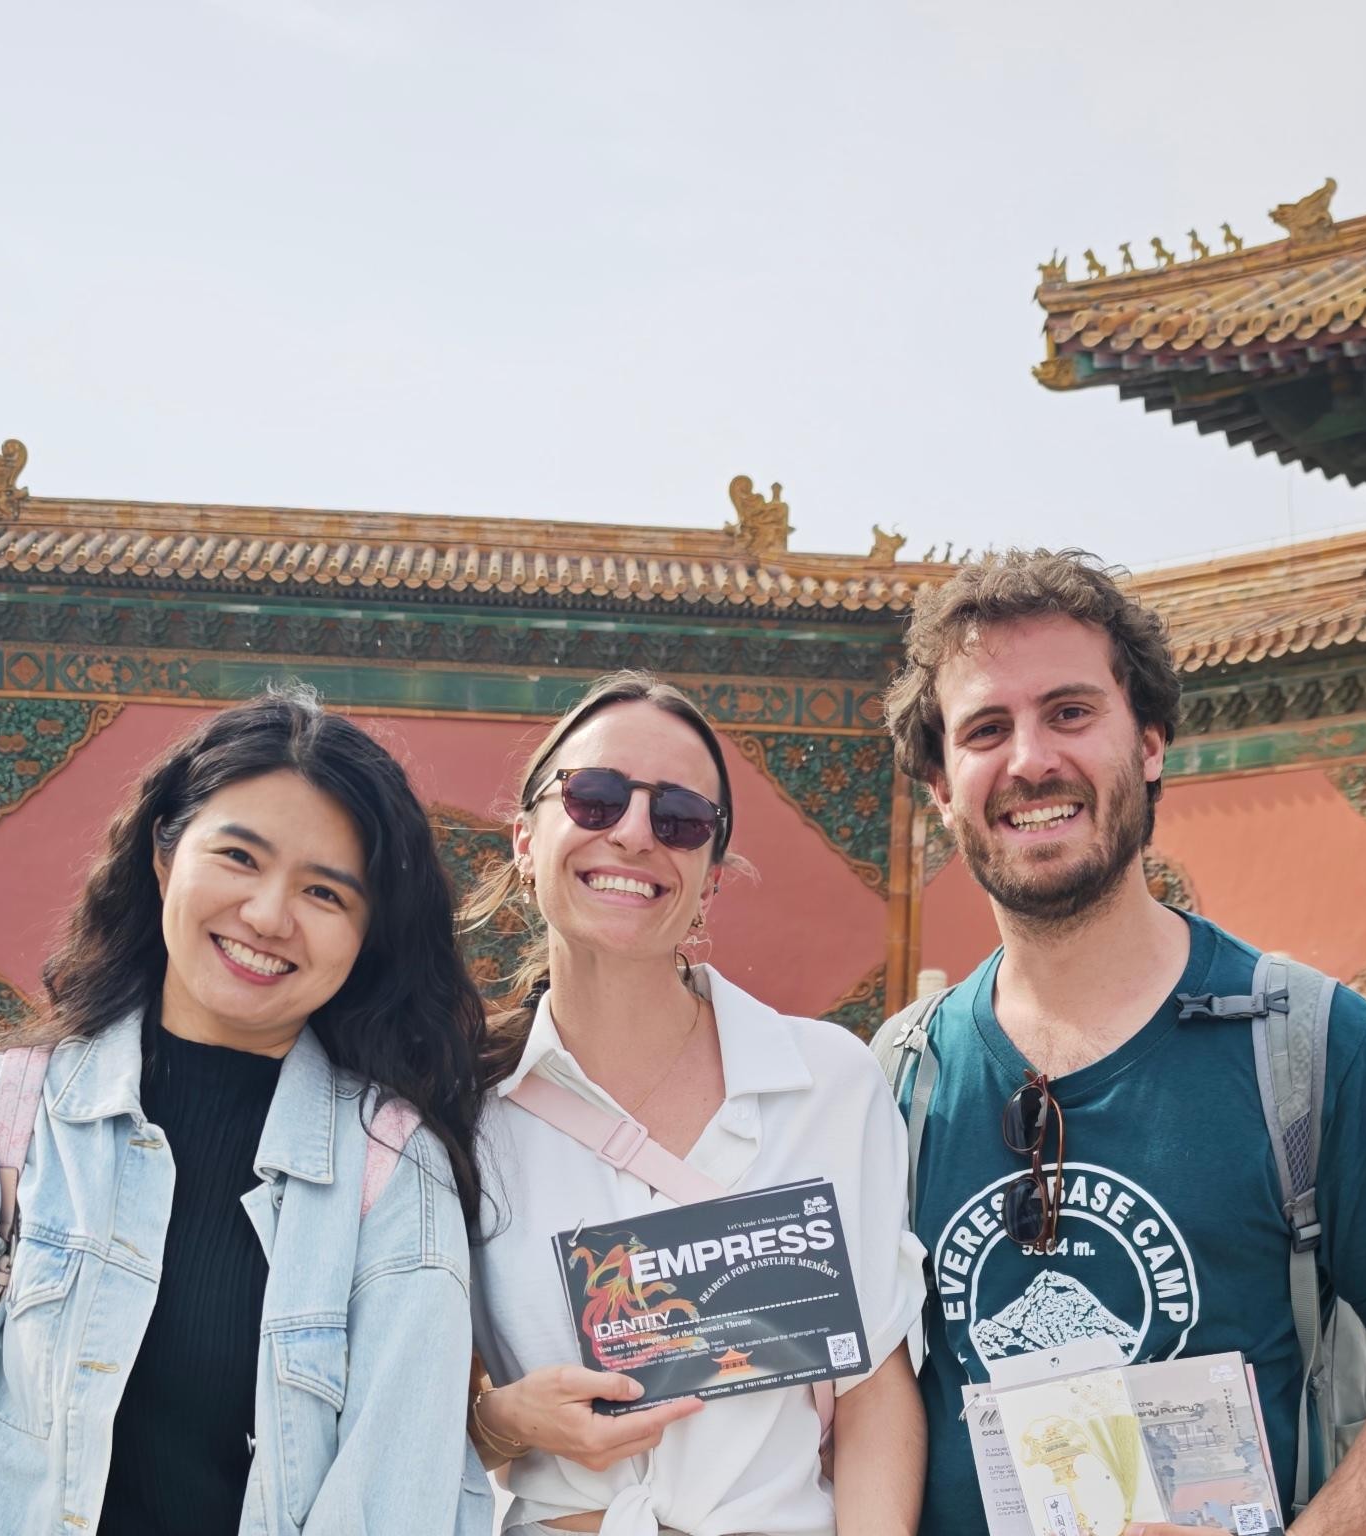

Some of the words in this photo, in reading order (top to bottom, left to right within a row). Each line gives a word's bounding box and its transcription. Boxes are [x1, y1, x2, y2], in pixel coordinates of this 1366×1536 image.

[629, 1219, 835, 1283] EMPRESS
[940, 1188, 1013, 1322] EVERES
[1046, 1175, 1136, 1226] BASE
[1132, 1218, 1189, 1323] CAMP
[1073, 1241, 1096, 1256] m.
[699, 1274, 731, 1305] SEARCH
[731, 1263, 750, 1278] FOR
[750, 1256, 796, 1270] PASTLIFE
[797, 1258, 841, 1280] MEMORY
[593, 1310, 670, 1339] IDENTITY
[597, 1344, 612, 1354] You
[614, 1343, 626, 1352] are
[627, 1340, 638, 1349] the
[640, 1334, 671, 1347] Empress
[672, 1331, 681, 1340] of
[682, 1329, 693, 1338] the
[695, 1323, 724, 1335] Phoenix
[725, 1317, 752, 1330] Throne
[1138, 1400, 1154, 1408] the
